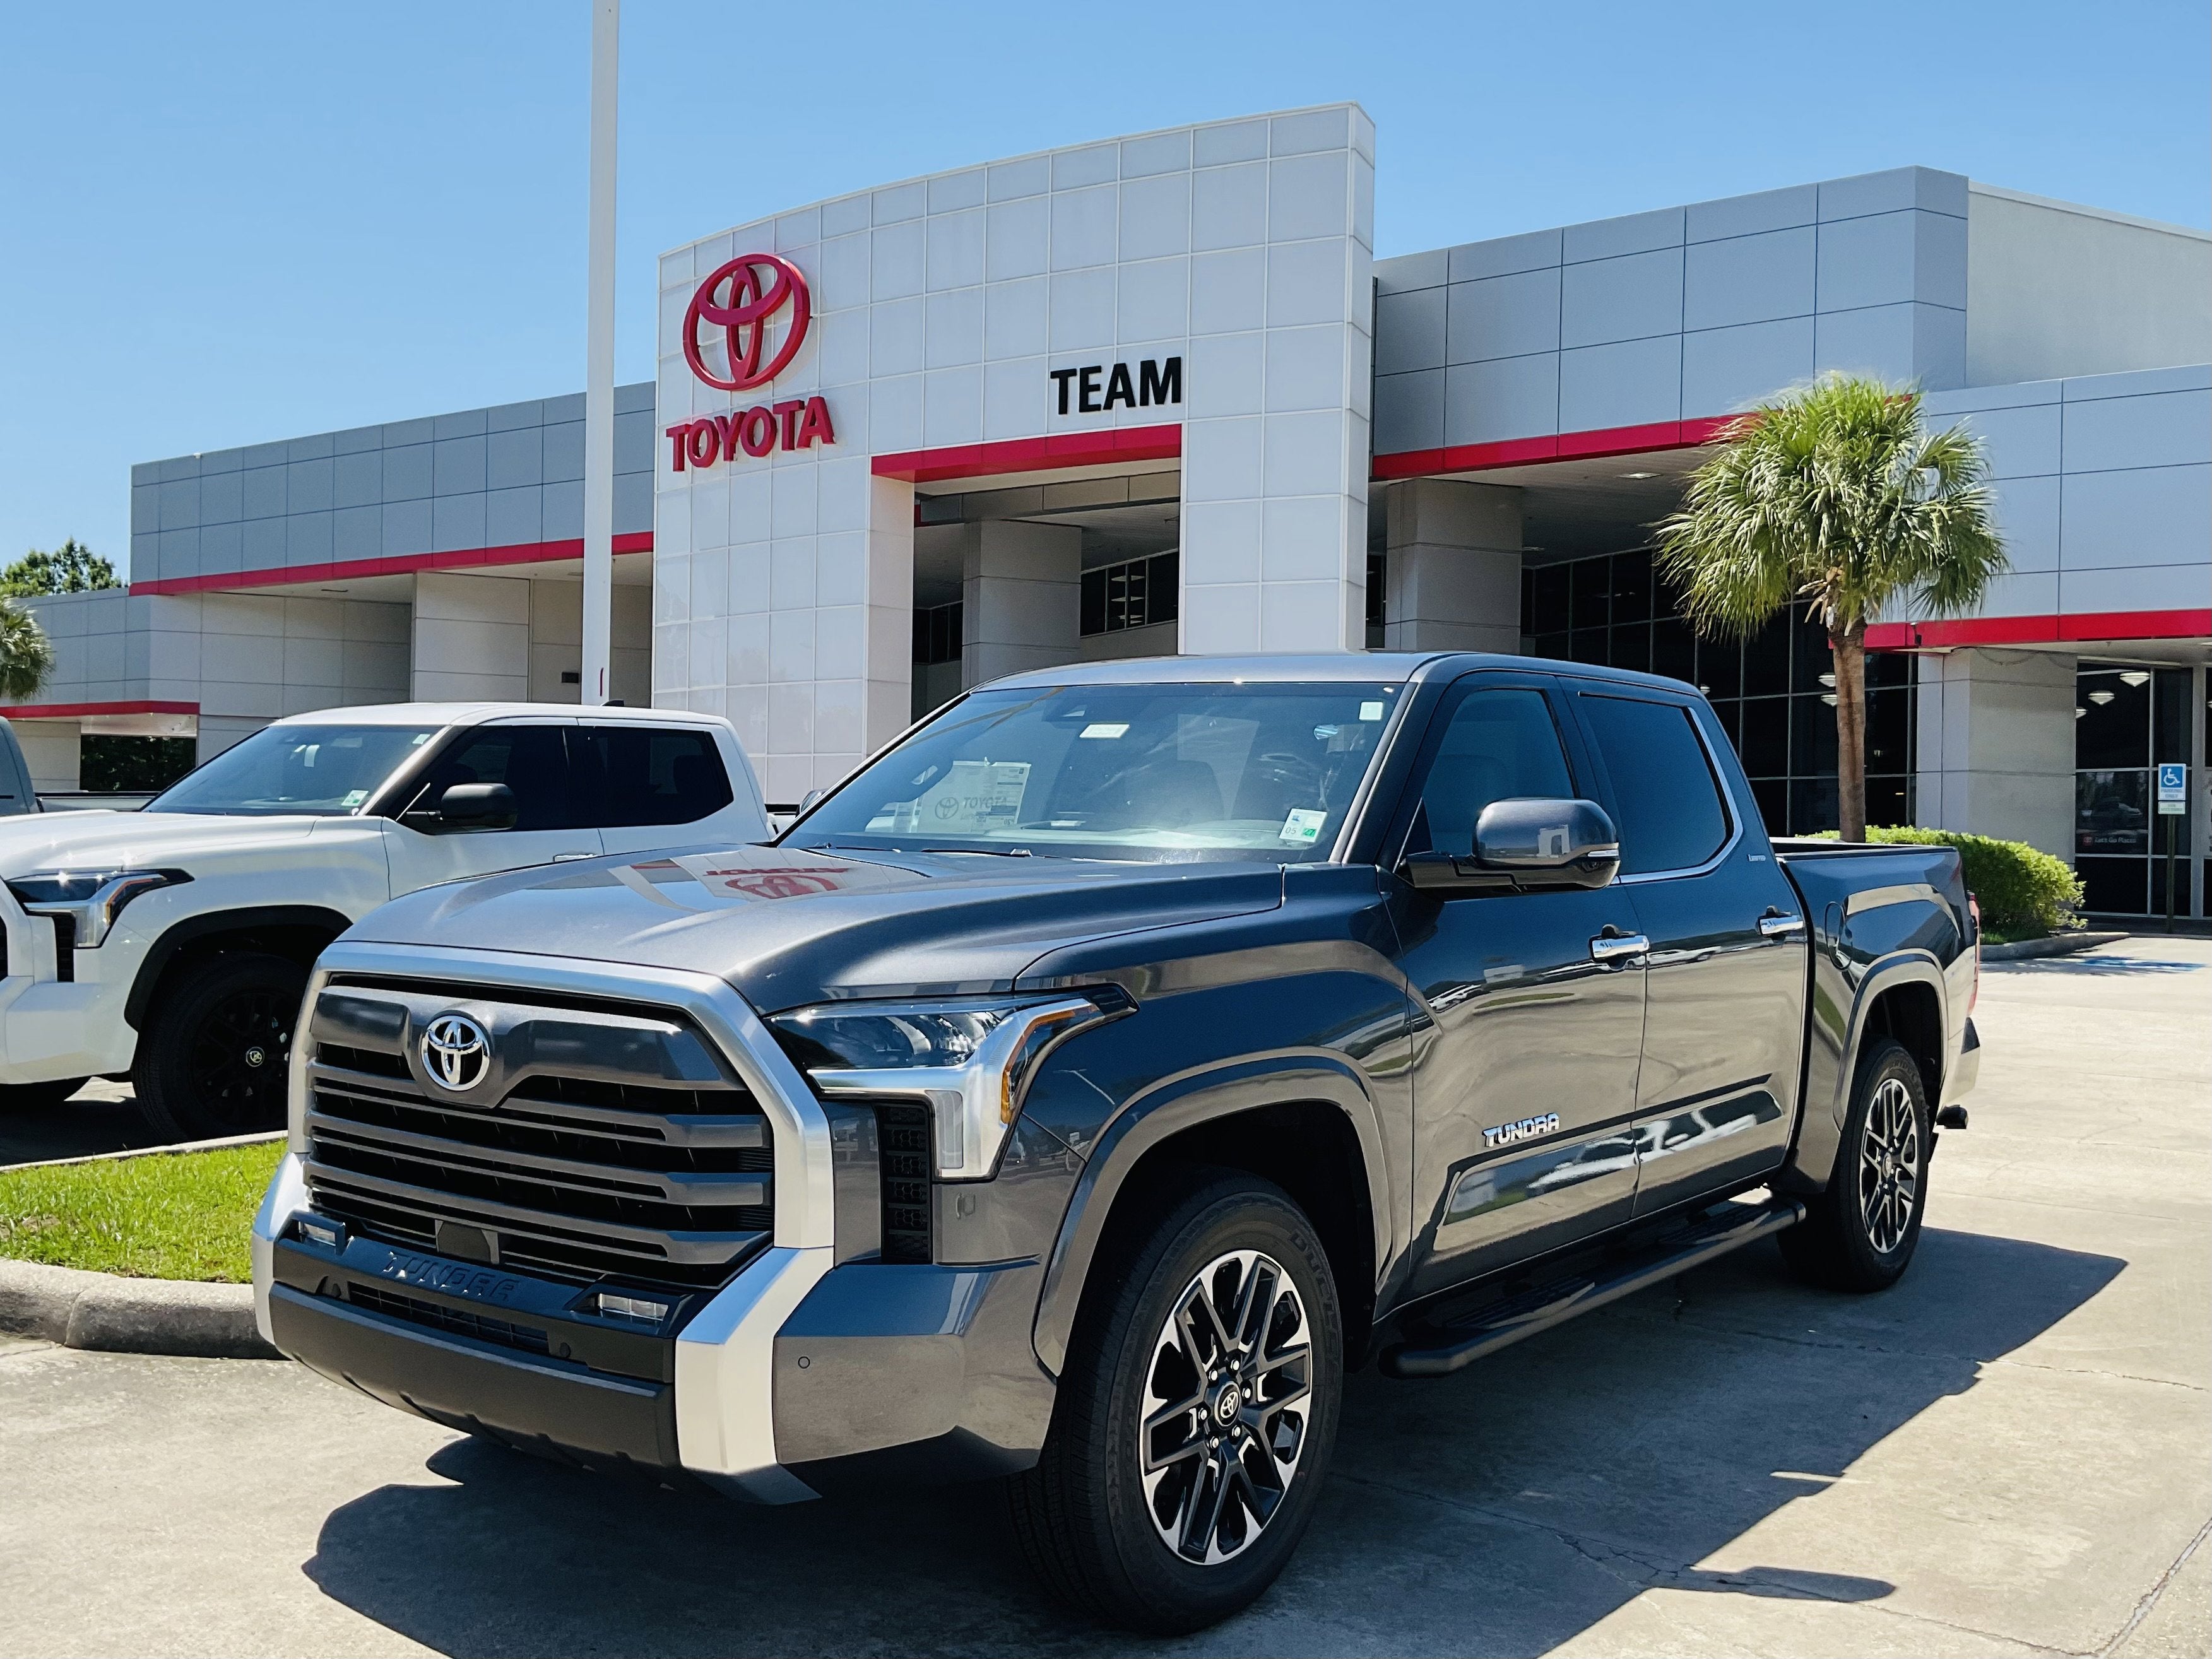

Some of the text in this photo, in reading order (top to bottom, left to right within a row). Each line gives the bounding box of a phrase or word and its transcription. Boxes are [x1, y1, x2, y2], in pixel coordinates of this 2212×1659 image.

[1050, 356, 1182, 415] TEAM
[666, 396, 835, 472] TOYOTA
[1285, 826, 1297, 834] 05
[1482, 1112, 1560, 1147] TUNDRA
[382, 1251, 520, 1302] TUNDRA
